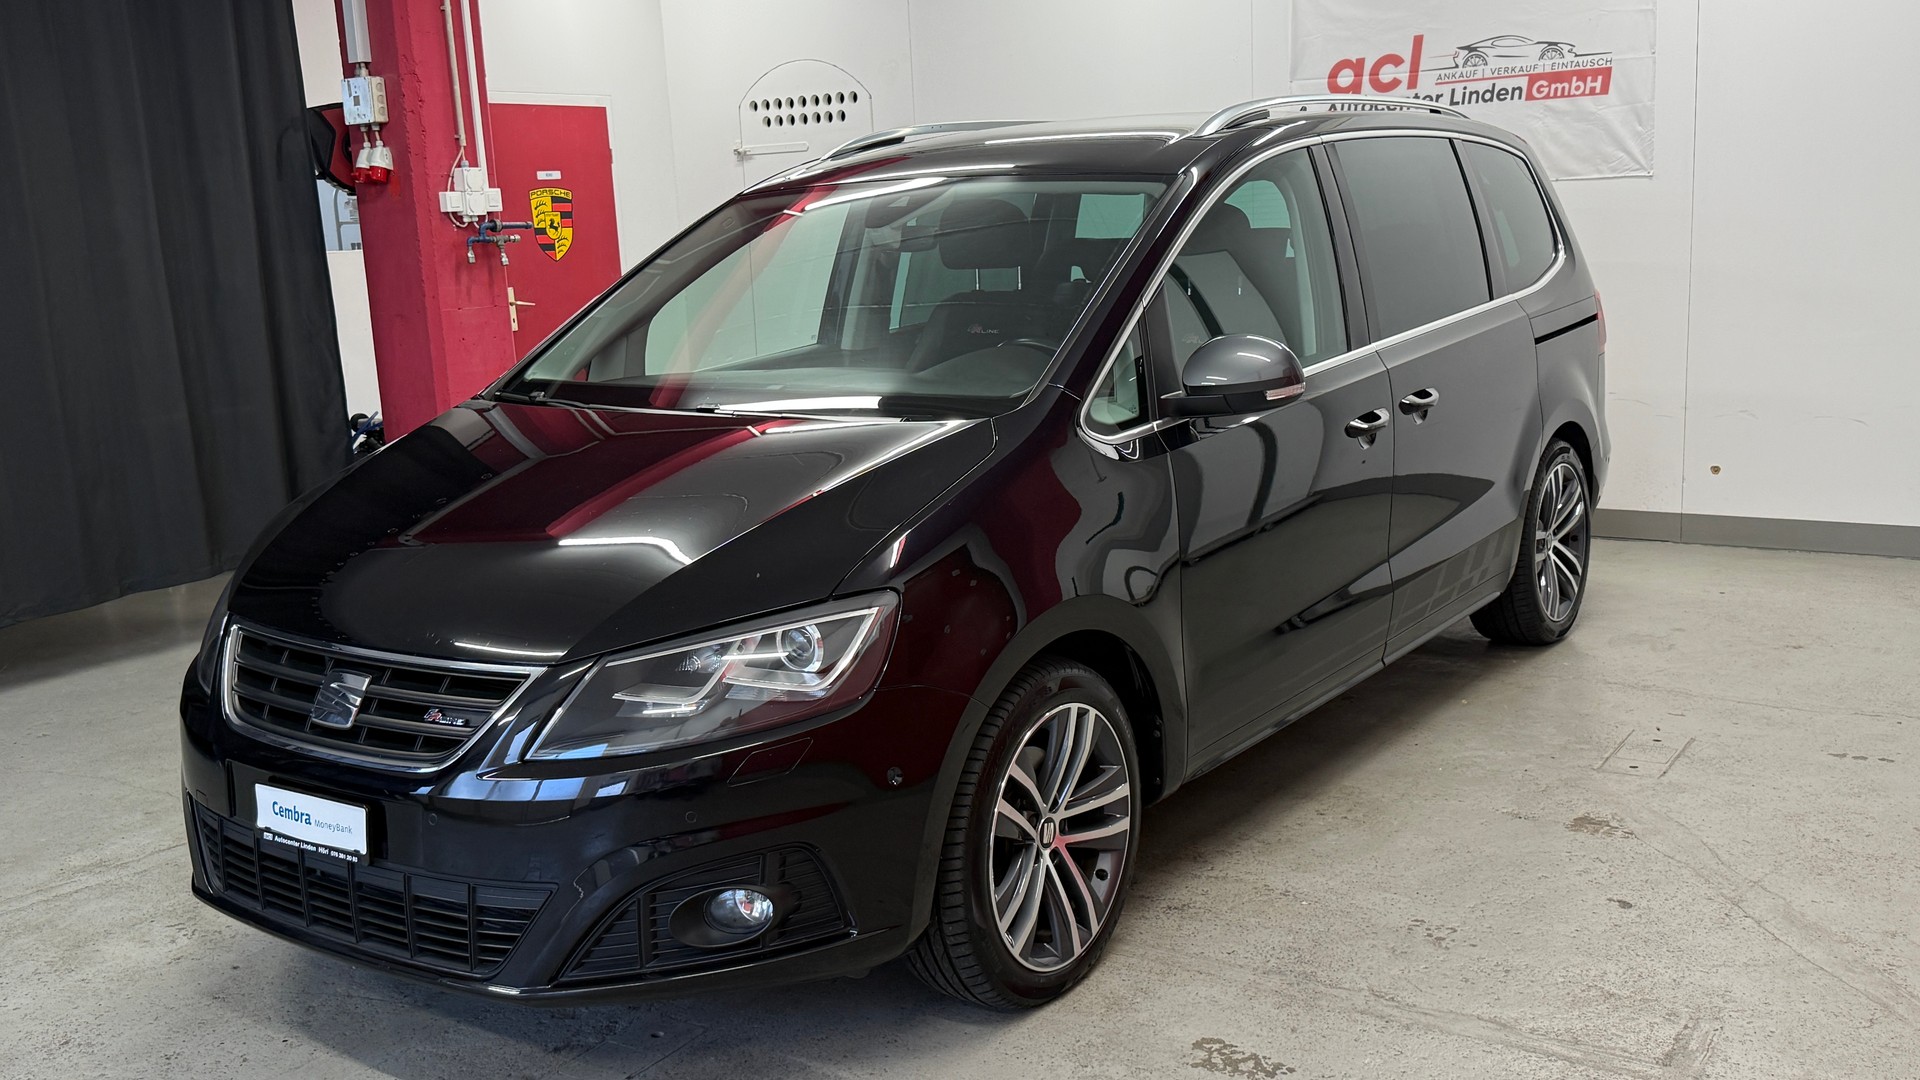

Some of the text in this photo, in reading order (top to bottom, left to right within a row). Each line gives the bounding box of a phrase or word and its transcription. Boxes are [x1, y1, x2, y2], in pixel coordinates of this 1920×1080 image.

[1327, 34, 1424, 94] acl
[1436, 57, 1613, 81] ANKAUF VERKAUF EINTAUSCH
[1449, 83, 1523, 106] Linden
[1531, 76, 1603, 98] GmbH
[530, 189, 571, 198] PORSCHE
[272, 801, 312, 825] Cembra
[314, 819, 353, 834] MoneyBank
[274, 835, 300, 847] Autocenter
[300, 842, 317, 851] Linden
